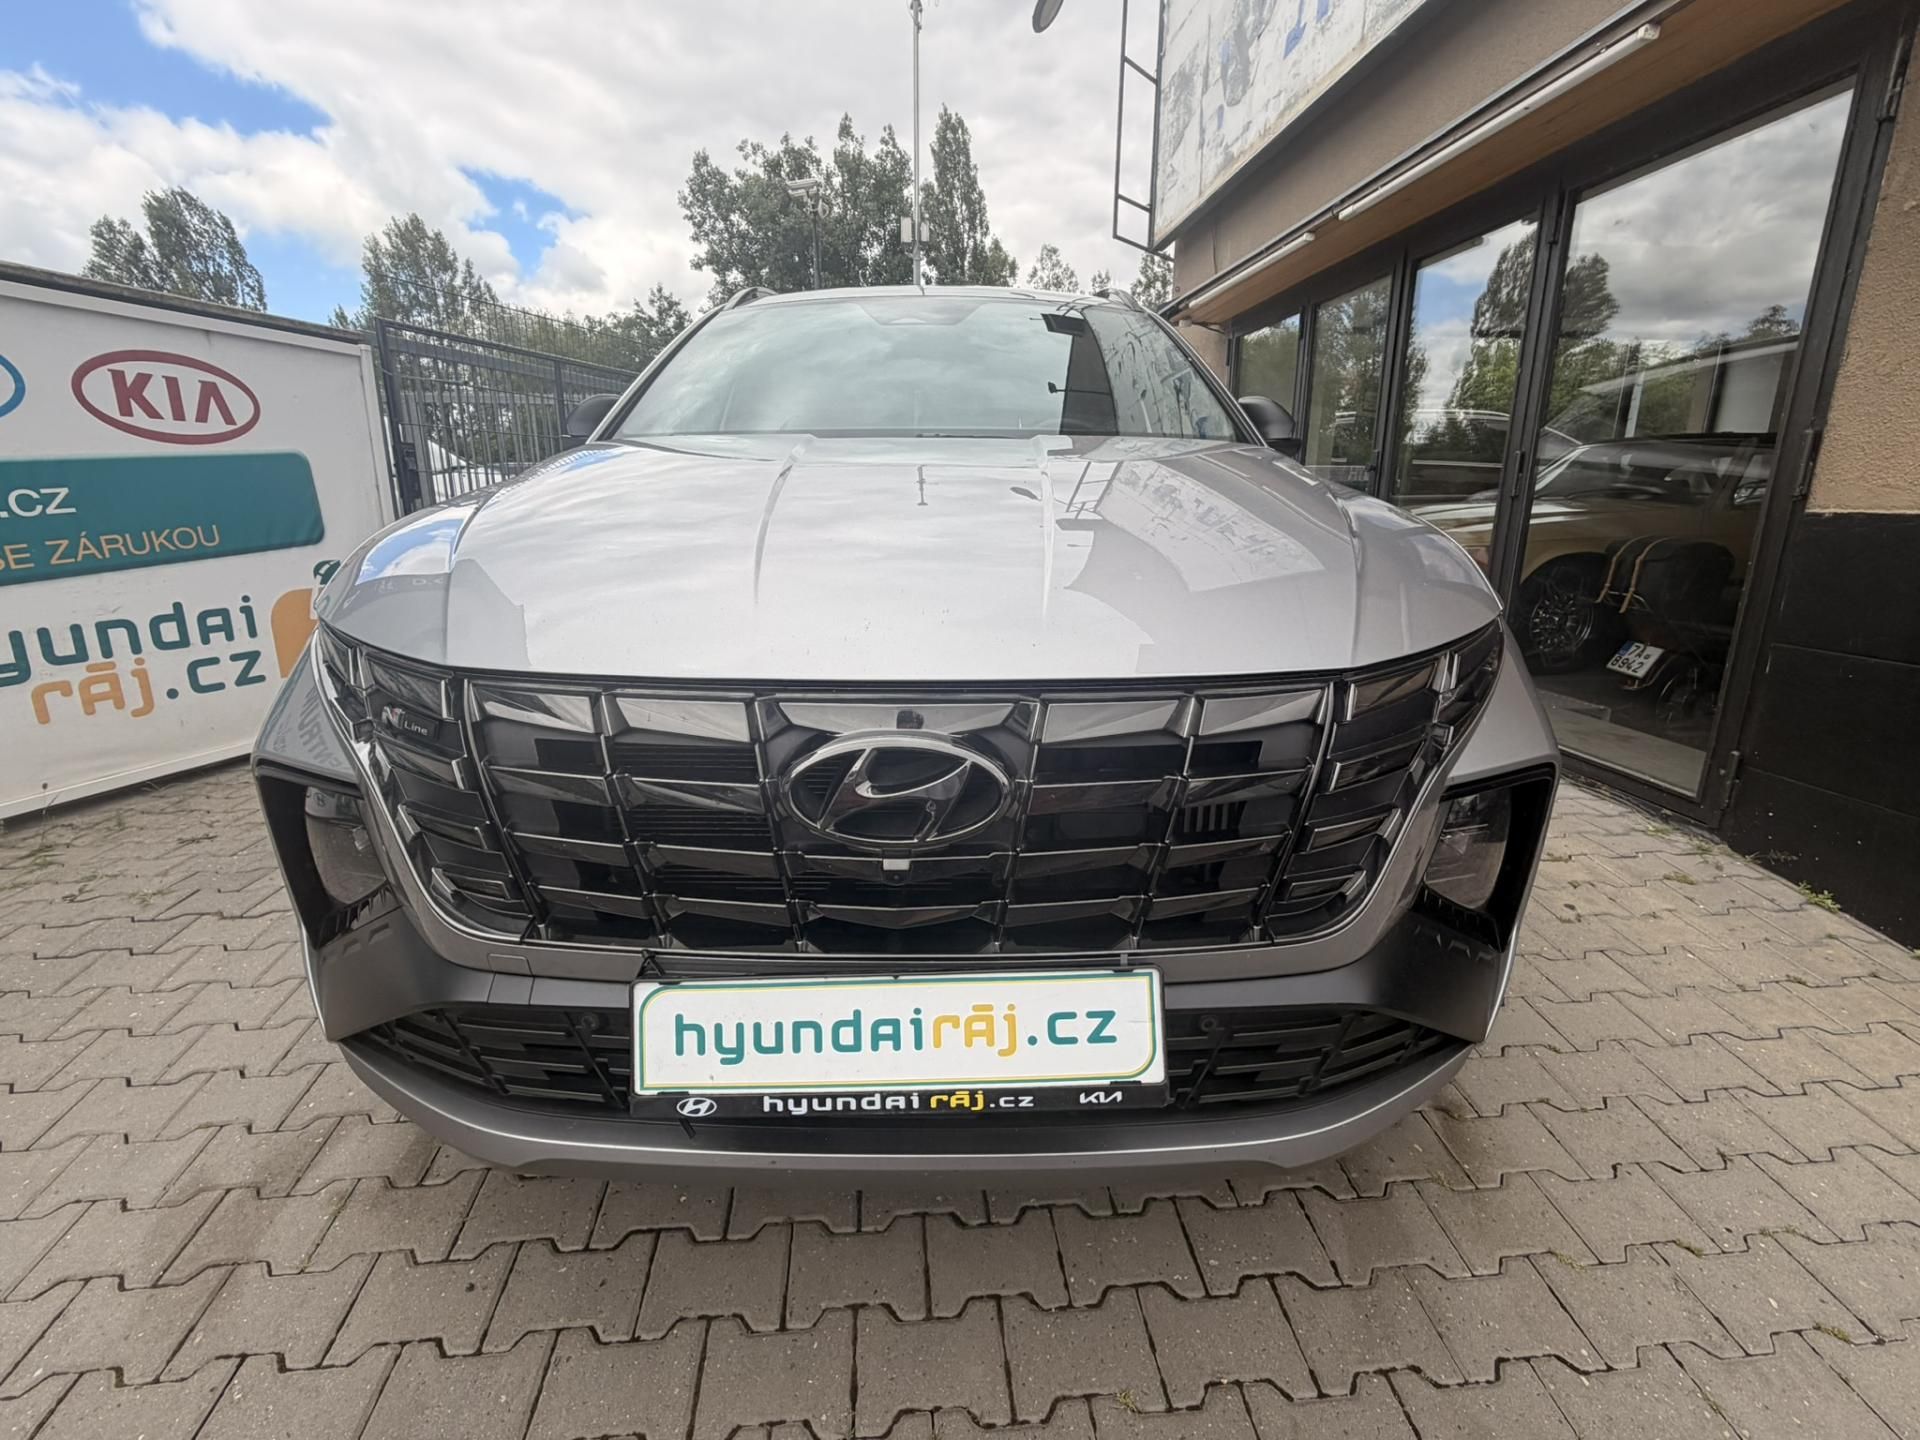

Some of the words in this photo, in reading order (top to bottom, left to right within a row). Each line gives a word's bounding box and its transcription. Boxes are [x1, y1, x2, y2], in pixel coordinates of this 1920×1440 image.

[107, 367, 238, 427] KIA
[45, 524, 221, 565] ZÁRUKOU
[1611, 655, 1645, 674] 8942
[404, 720, 428, 736] Line
